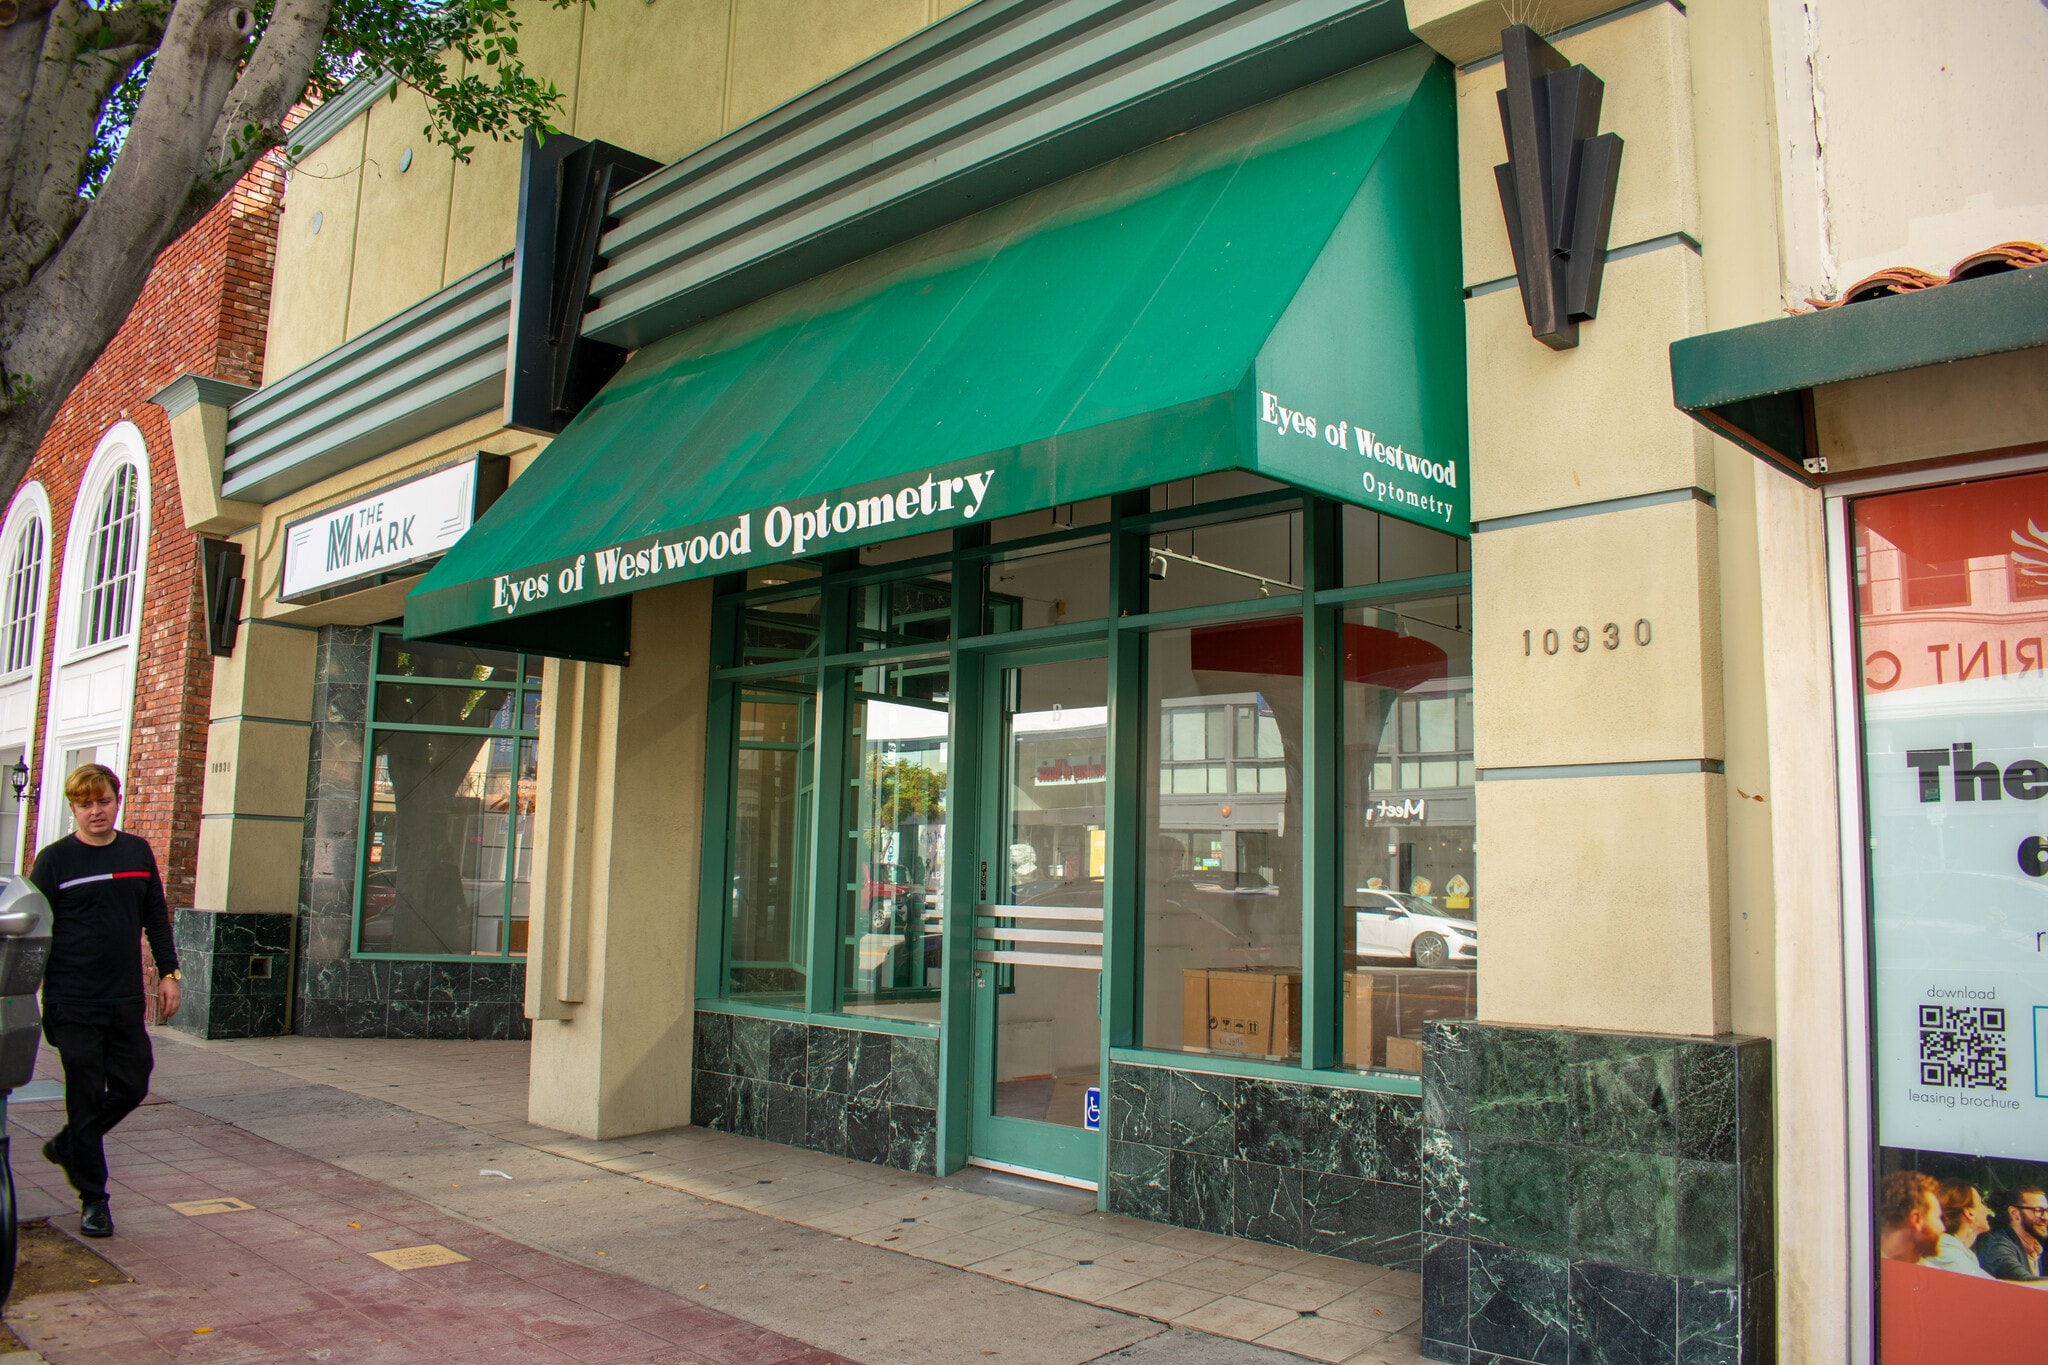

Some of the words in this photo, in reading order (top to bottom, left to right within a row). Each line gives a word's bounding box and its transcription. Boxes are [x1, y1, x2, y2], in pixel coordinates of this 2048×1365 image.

[1260, 391, 1317, 438] Eyes
[1324, 420, 1348, 450] of
[1354, 426, 1457, 489] Westwood
[359, 502, 384, 528] THE
[1362, 471, 1453, 523] Optometry
[355, 514, 416, 563] MARK
[492, 573, 549, 615] Eyes
[557, 554, 586, 594] of
[594, 513, 751, 585] Westwood
[763, 469, 995, 555] Optometry
[1522, 618, 1651, 657] 10930
[1906, 742, 2048, 803] The
[1926, 984, 1996, 1000] download
[1908, 1088, 1956, 1108] leasing
[1960, 1092, 2020, 1110] brochure
